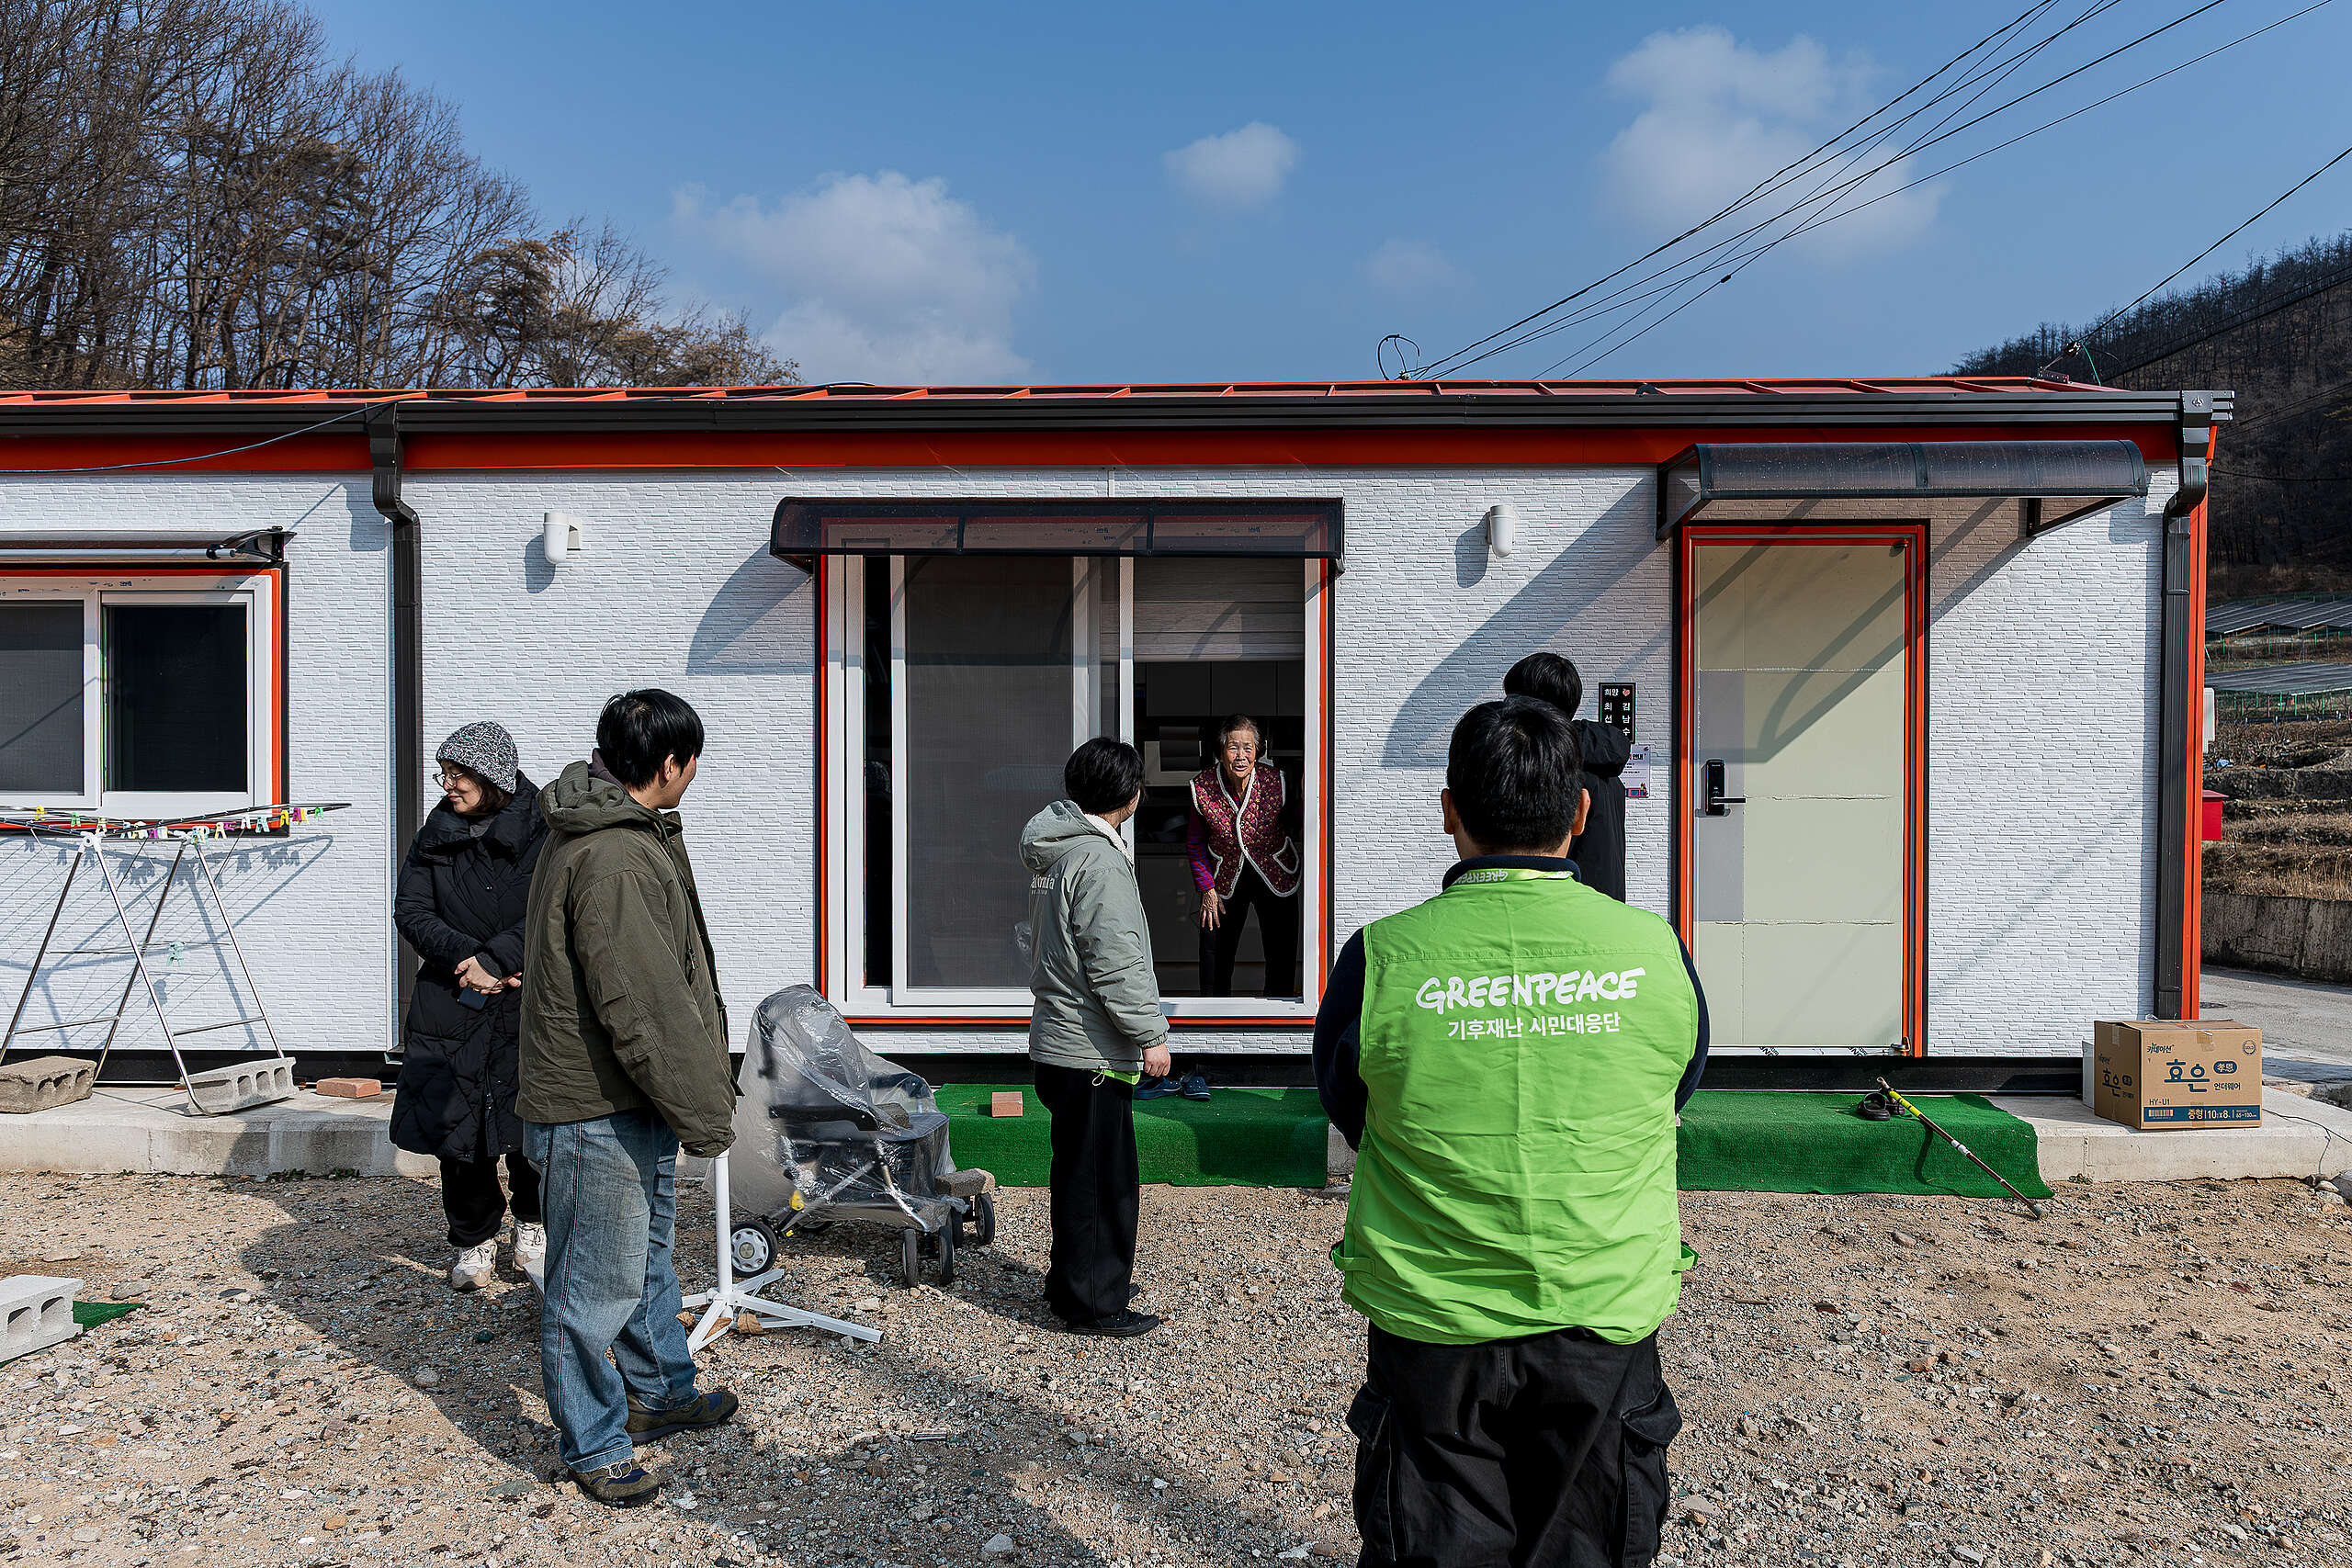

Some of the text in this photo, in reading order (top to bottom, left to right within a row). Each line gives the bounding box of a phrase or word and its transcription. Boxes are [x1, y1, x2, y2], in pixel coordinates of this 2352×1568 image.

[1416, 967, 1646, 1015] GREENPEACE
[1448, 1011, 1622, 1040] 기후재난 시민대응단
[2214, 1082, 2241, 1090] 언더웨어
